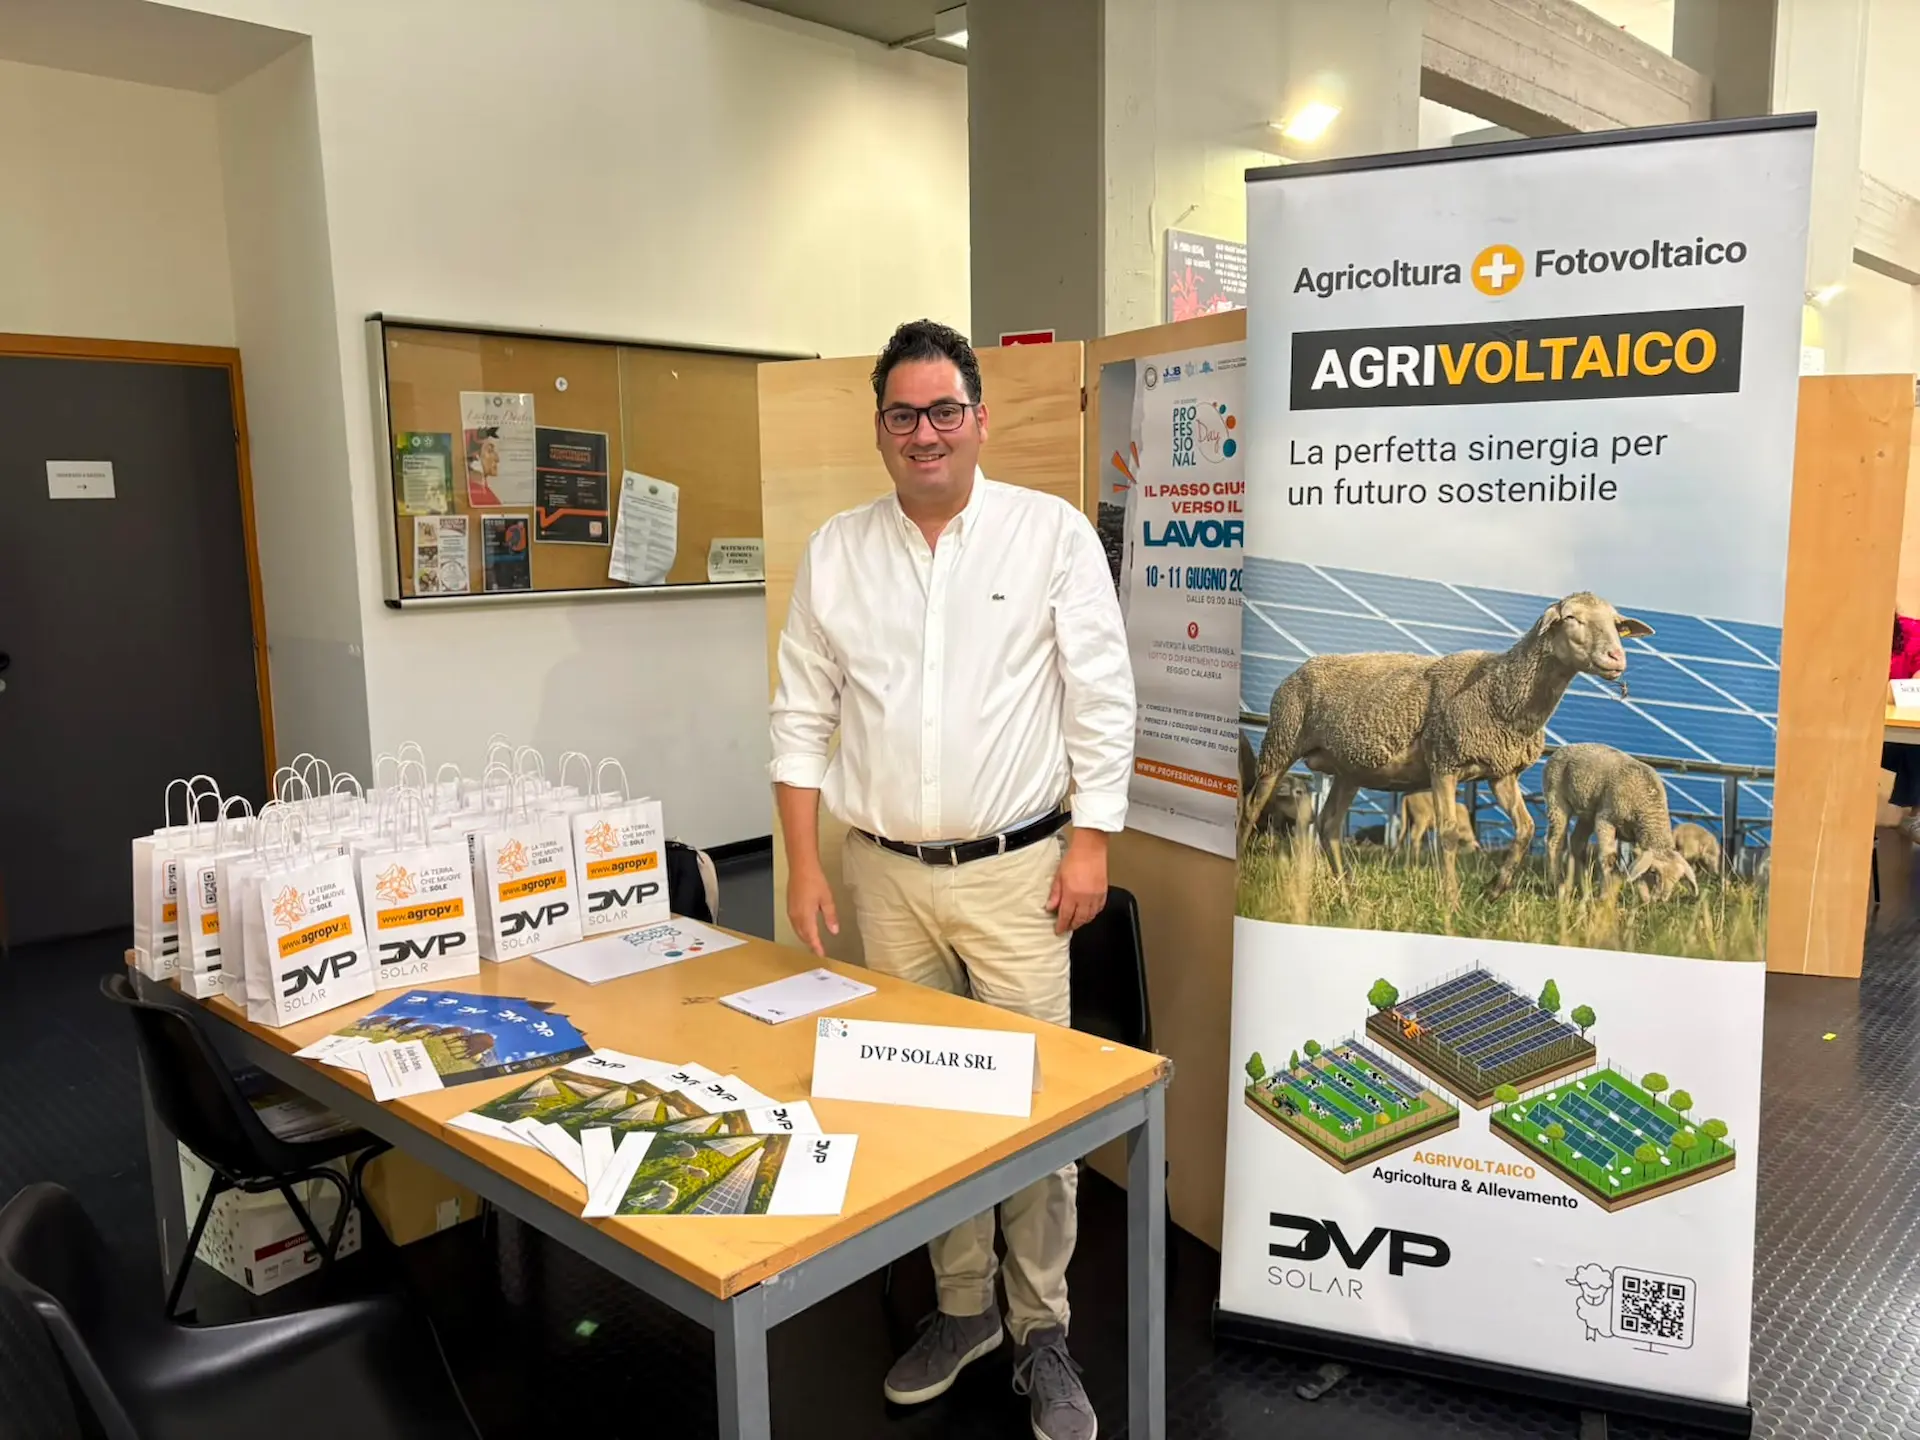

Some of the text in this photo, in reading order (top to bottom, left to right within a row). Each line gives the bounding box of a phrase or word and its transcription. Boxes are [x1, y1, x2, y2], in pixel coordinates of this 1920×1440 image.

[1293, 259, 1461, 298] Agricoltura
[1535, 236, 1747, 277] Fotovoltaico
[1311, 328, 1717, 390] AGRIVOLTAICO
[1173, 406, 1197, 422] PRO
[1173, 422, 1193, 436] FES
[1196, 419, 1221, 453] Day
[1173, 437, 1194, 452] SIO
[1289, 431, 1668, 470] La perfetta sinergia per
[1173, 452, 1197, 467] NAL
[1144, 485, 1157, 497] IL
[1160, 482, 1210, 497] PASSO
[1288, 473, 1618, 506] un futuro sostenibile
[1172, 500, 1242, 514] VERSO IL
[1146, 565, 1158, 587] 10
[1168, 566, 1181, 588] 11
[1186, 566, 1227, 591] GIUGNO
[1186, 594, 1205, 604] DALLE
[1227, 597, 1242, 607] ALLE
[1166, 665, 1222, 680] REGGIO CALABRIA
[629, 838, 645, 846] SOLE
[538, 856, 553, 865] SOLE
[591, 857, 654, 875] www.agropv.it
[420, 866, 454, 878] LA TERRA
[420, 872, 462, 886] CHE MUOVE
[316, 883, 337, 895] TERRA
[322, 888, 346, 901] MUOVE
[429, 883, 448, 893] SOLE
[502, 875, 564, 896] www.agropv.it
[316, 901, 333, 912] SOLE
[587, 882, 660, 913] DVP
[381, 903, 460, 924] www.agropv.it
[500, 902, 569, 937] DVP
[589, 909, 628, 926] SOLAR
[281, 921, 349, 952] www.agropv.it
[501, 931, 540, 951] SOLAR
[379, 931, 466, 966] DVP
[281, 950, 358, 998] DVP
[380, 962, 429, 980] SOLAR
[284, 988, 327, 1012] SOLAR
[587, 1057, 626, 1069] DVP
[860, 1044, 997, 1071] DVP SOLAR SRL
[707, 1084, 738, 1102] DVP
[772, 1108, 793, 1130] DVP
[812, 1140, 831, 1164] DVP
[1412, 1151, 1536, 1180] AGRIVOLTAICO
[1372, 1166, 1579, 1209] Agricoltura & Allevamento
[1268, 1212, 1451, 1277] DVP
[1268, 1265, 1363, 1300] SOLAR
